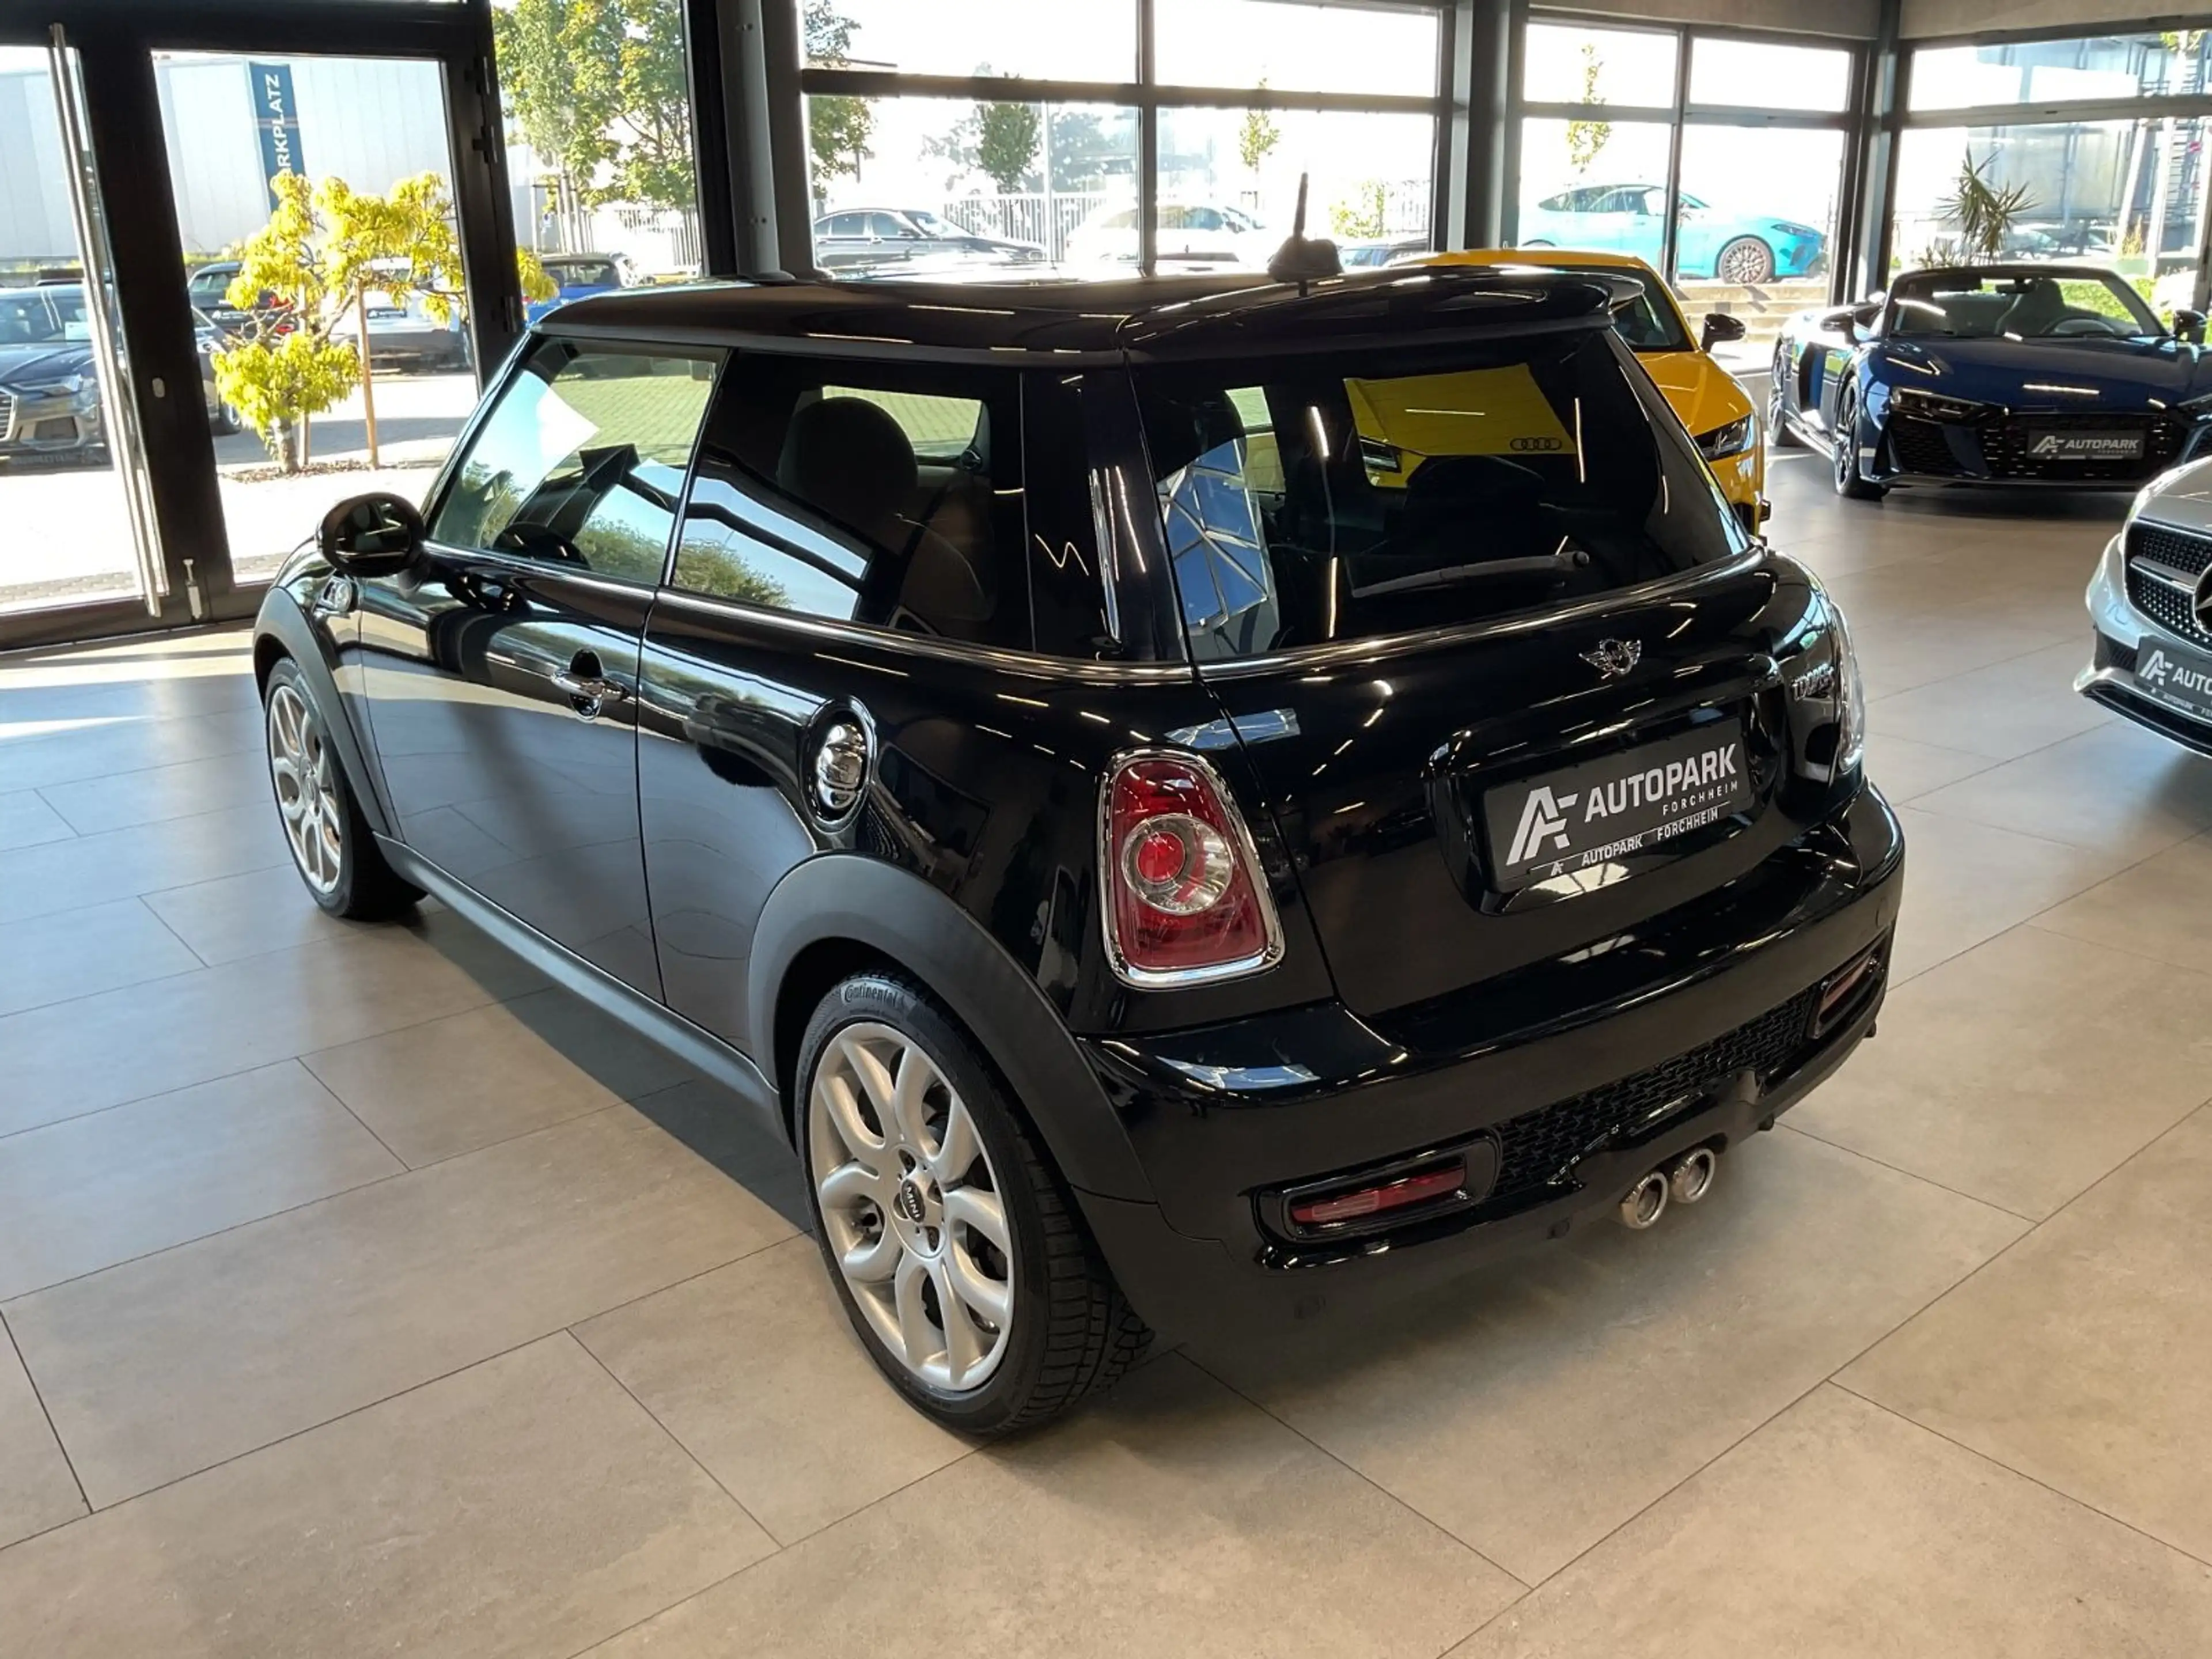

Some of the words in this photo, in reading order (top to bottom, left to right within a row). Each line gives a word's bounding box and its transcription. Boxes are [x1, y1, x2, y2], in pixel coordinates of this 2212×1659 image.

[265, 73, 291, 168] RKPLATZ
[2065, 439, 2139, 449] AUTOPARK
[1584, 743, 1736, 823] AUTOPARK
[1662, 779, 1738, 816] FORCHHEIM
[1581, 835, 1643, 866] AUTOPARK
[1657, 806, 1718, 841] FORCHHEIM
[844, 983, 899, 1007] Continental
[904, 1186, 921, 1218] MINI
